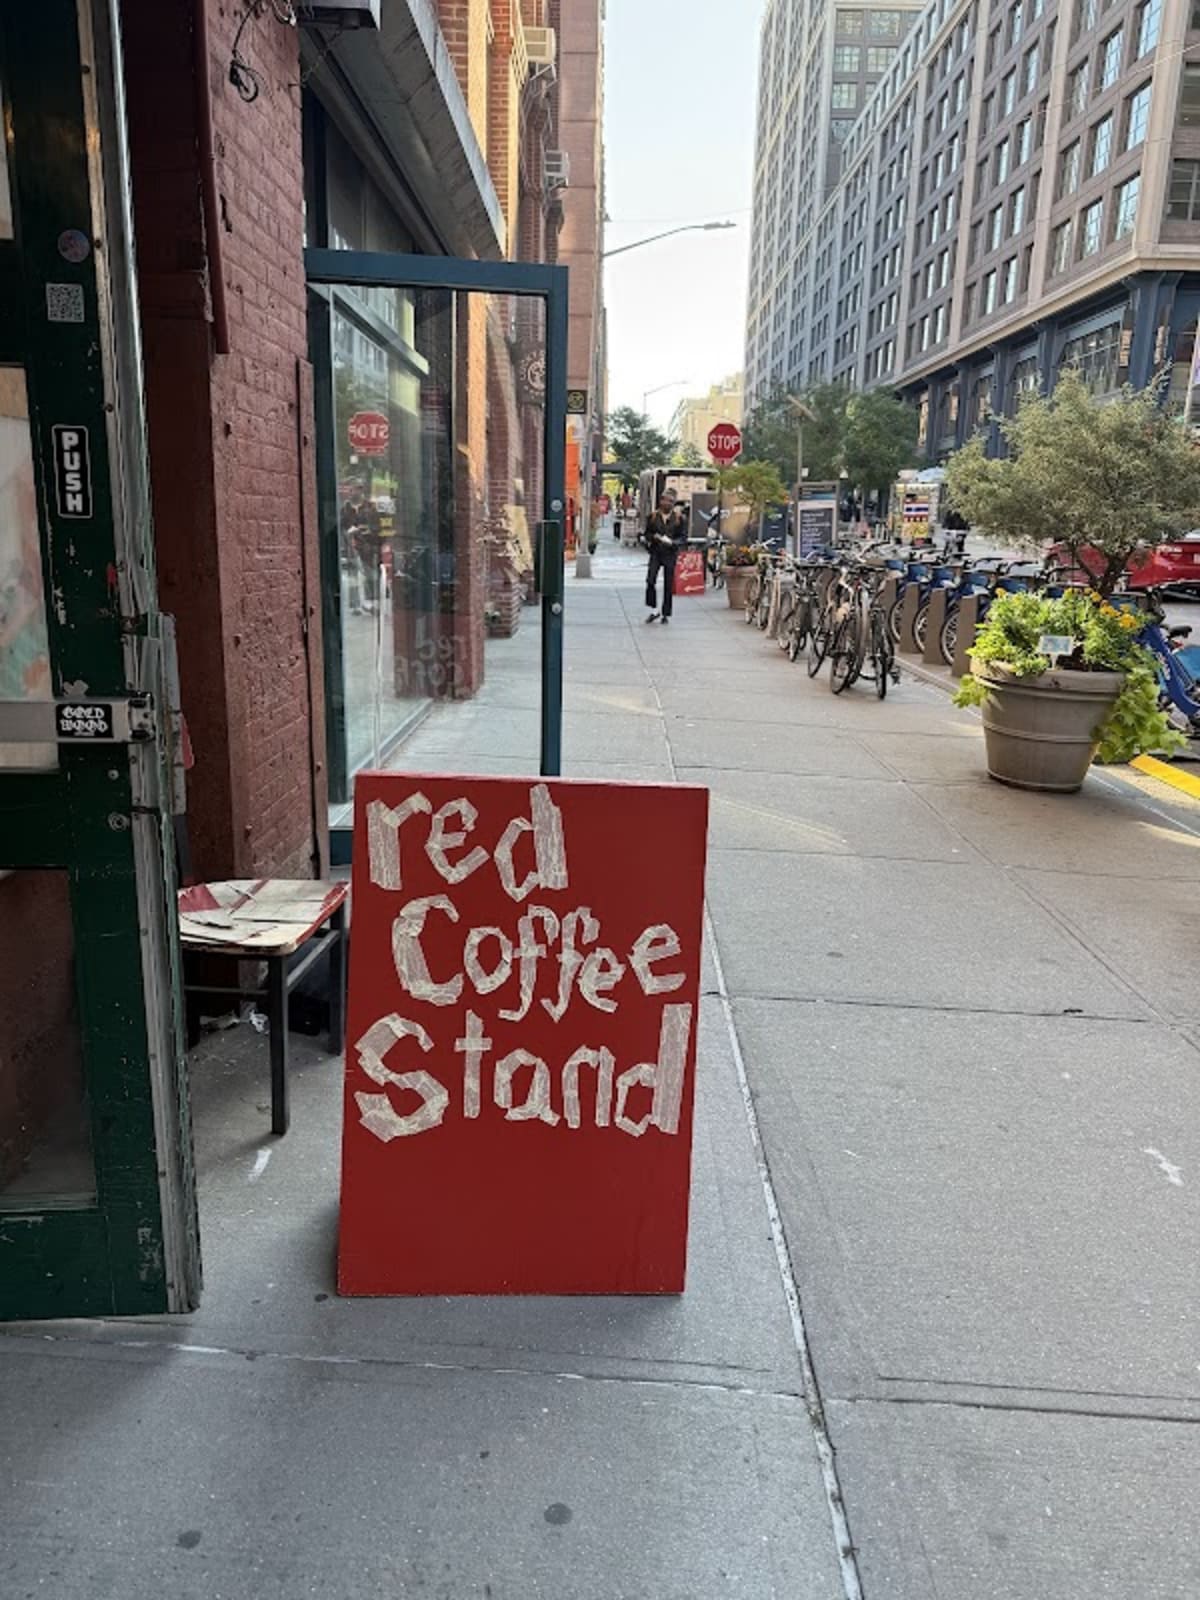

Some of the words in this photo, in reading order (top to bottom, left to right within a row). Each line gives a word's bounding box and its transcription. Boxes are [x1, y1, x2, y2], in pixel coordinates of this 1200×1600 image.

[61, 430, 83, 513] PUSH
[709, 434, 740, 450] STOP
[366, 783, 568, 902] red
[391, 894, 686, 1023] Coffee
[354, 1003, 692, 1144] Stand
